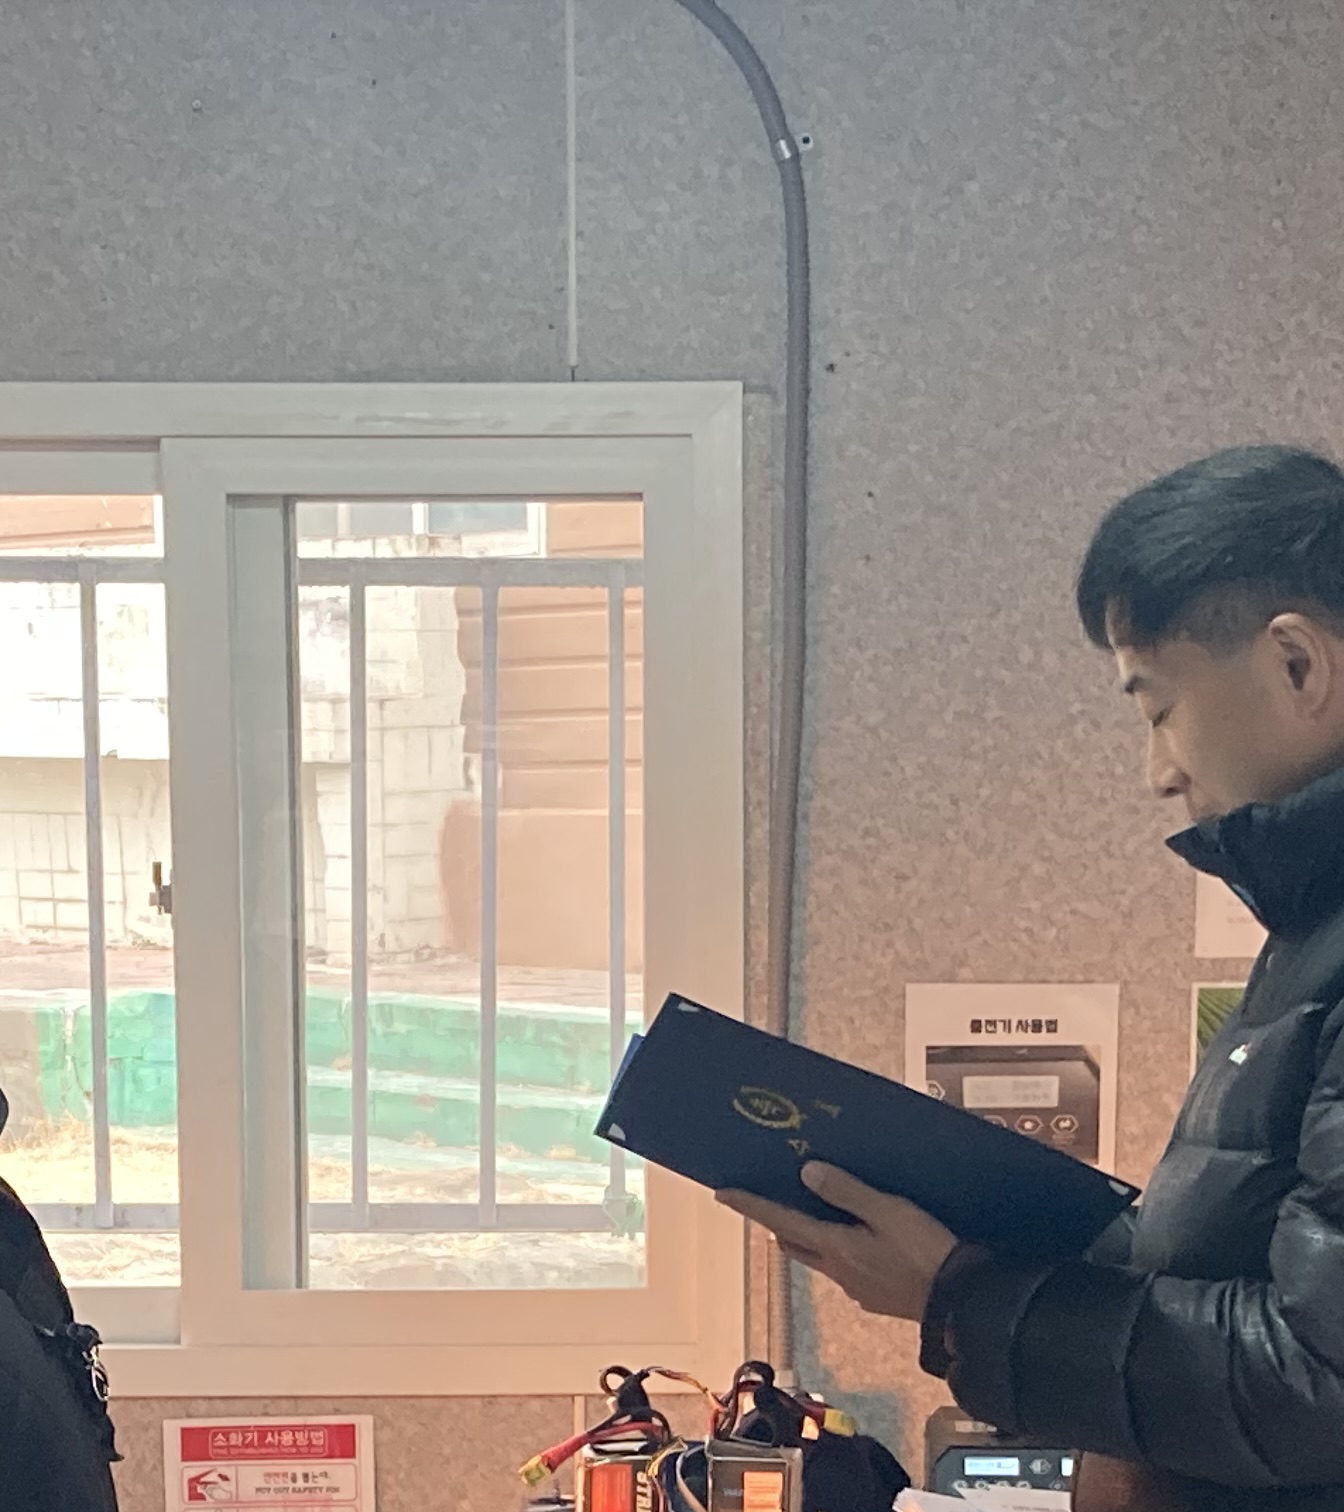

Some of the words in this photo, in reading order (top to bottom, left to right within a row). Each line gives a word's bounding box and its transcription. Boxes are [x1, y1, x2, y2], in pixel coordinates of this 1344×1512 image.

[1015, 1018, 1058, 1034] 사용법
[213, 1431, 259, 1447] 소화기
[264, 1429, 325, 1447] 사용방법
